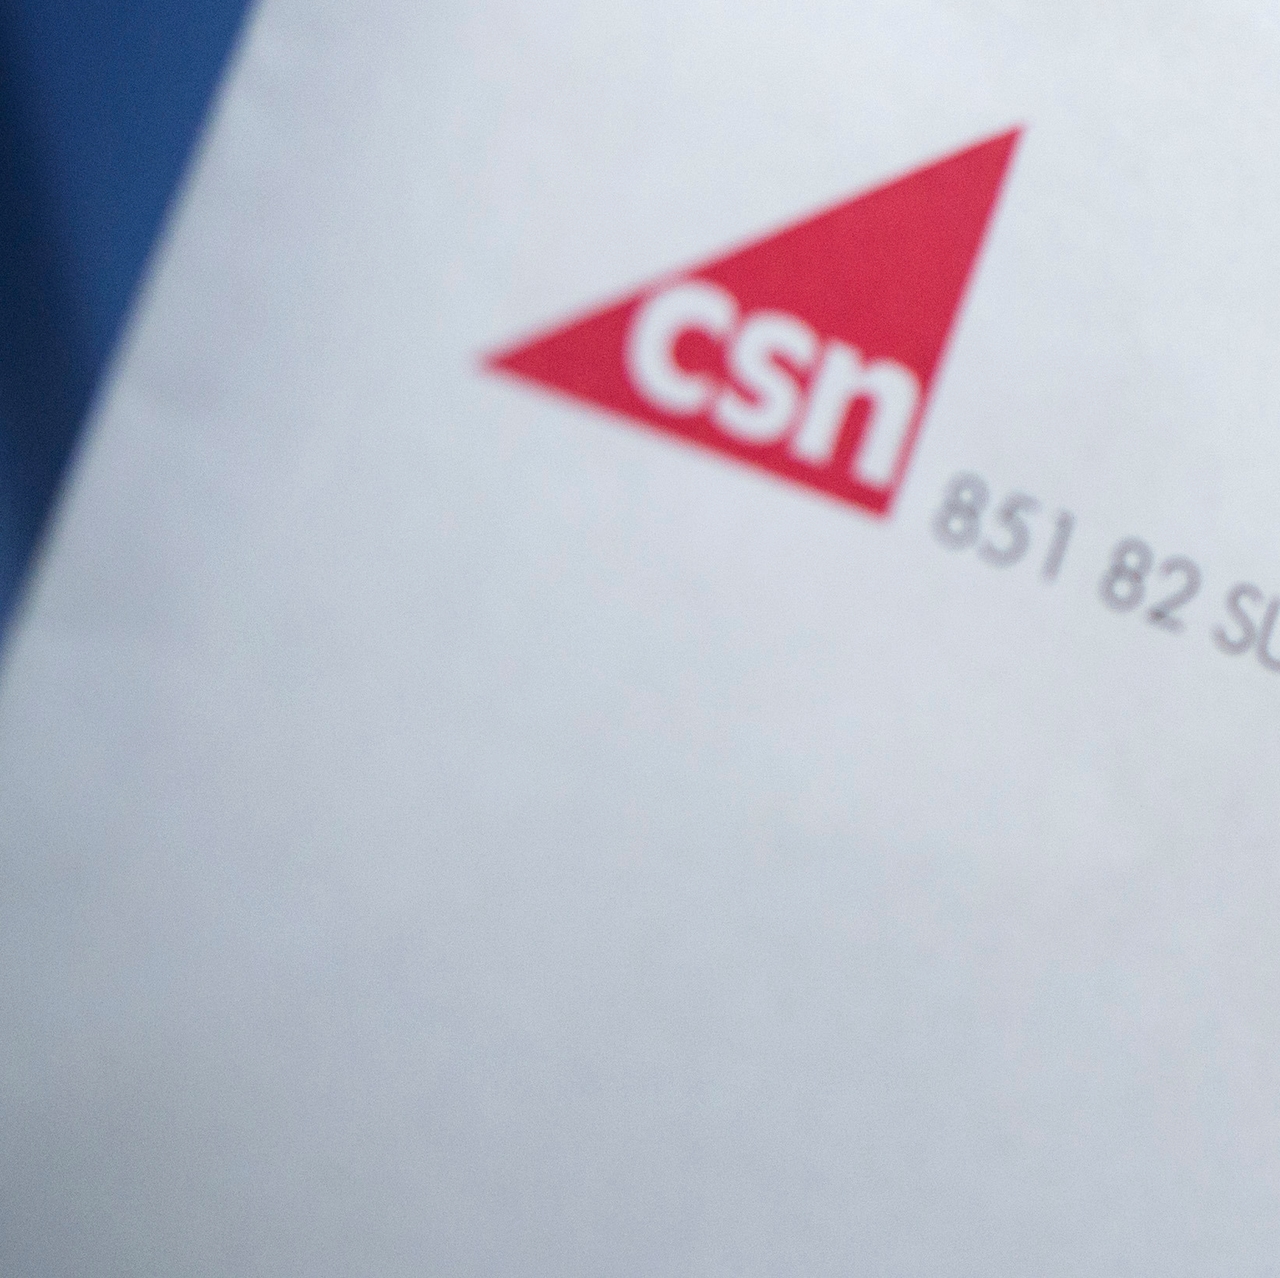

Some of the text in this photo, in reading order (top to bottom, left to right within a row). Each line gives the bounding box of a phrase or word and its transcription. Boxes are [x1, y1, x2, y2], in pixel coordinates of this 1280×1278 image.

[623, 278, 921, 491] csn
[931, 471, 1076, 583] 851
[1097, 536, 1203, 635] 82
